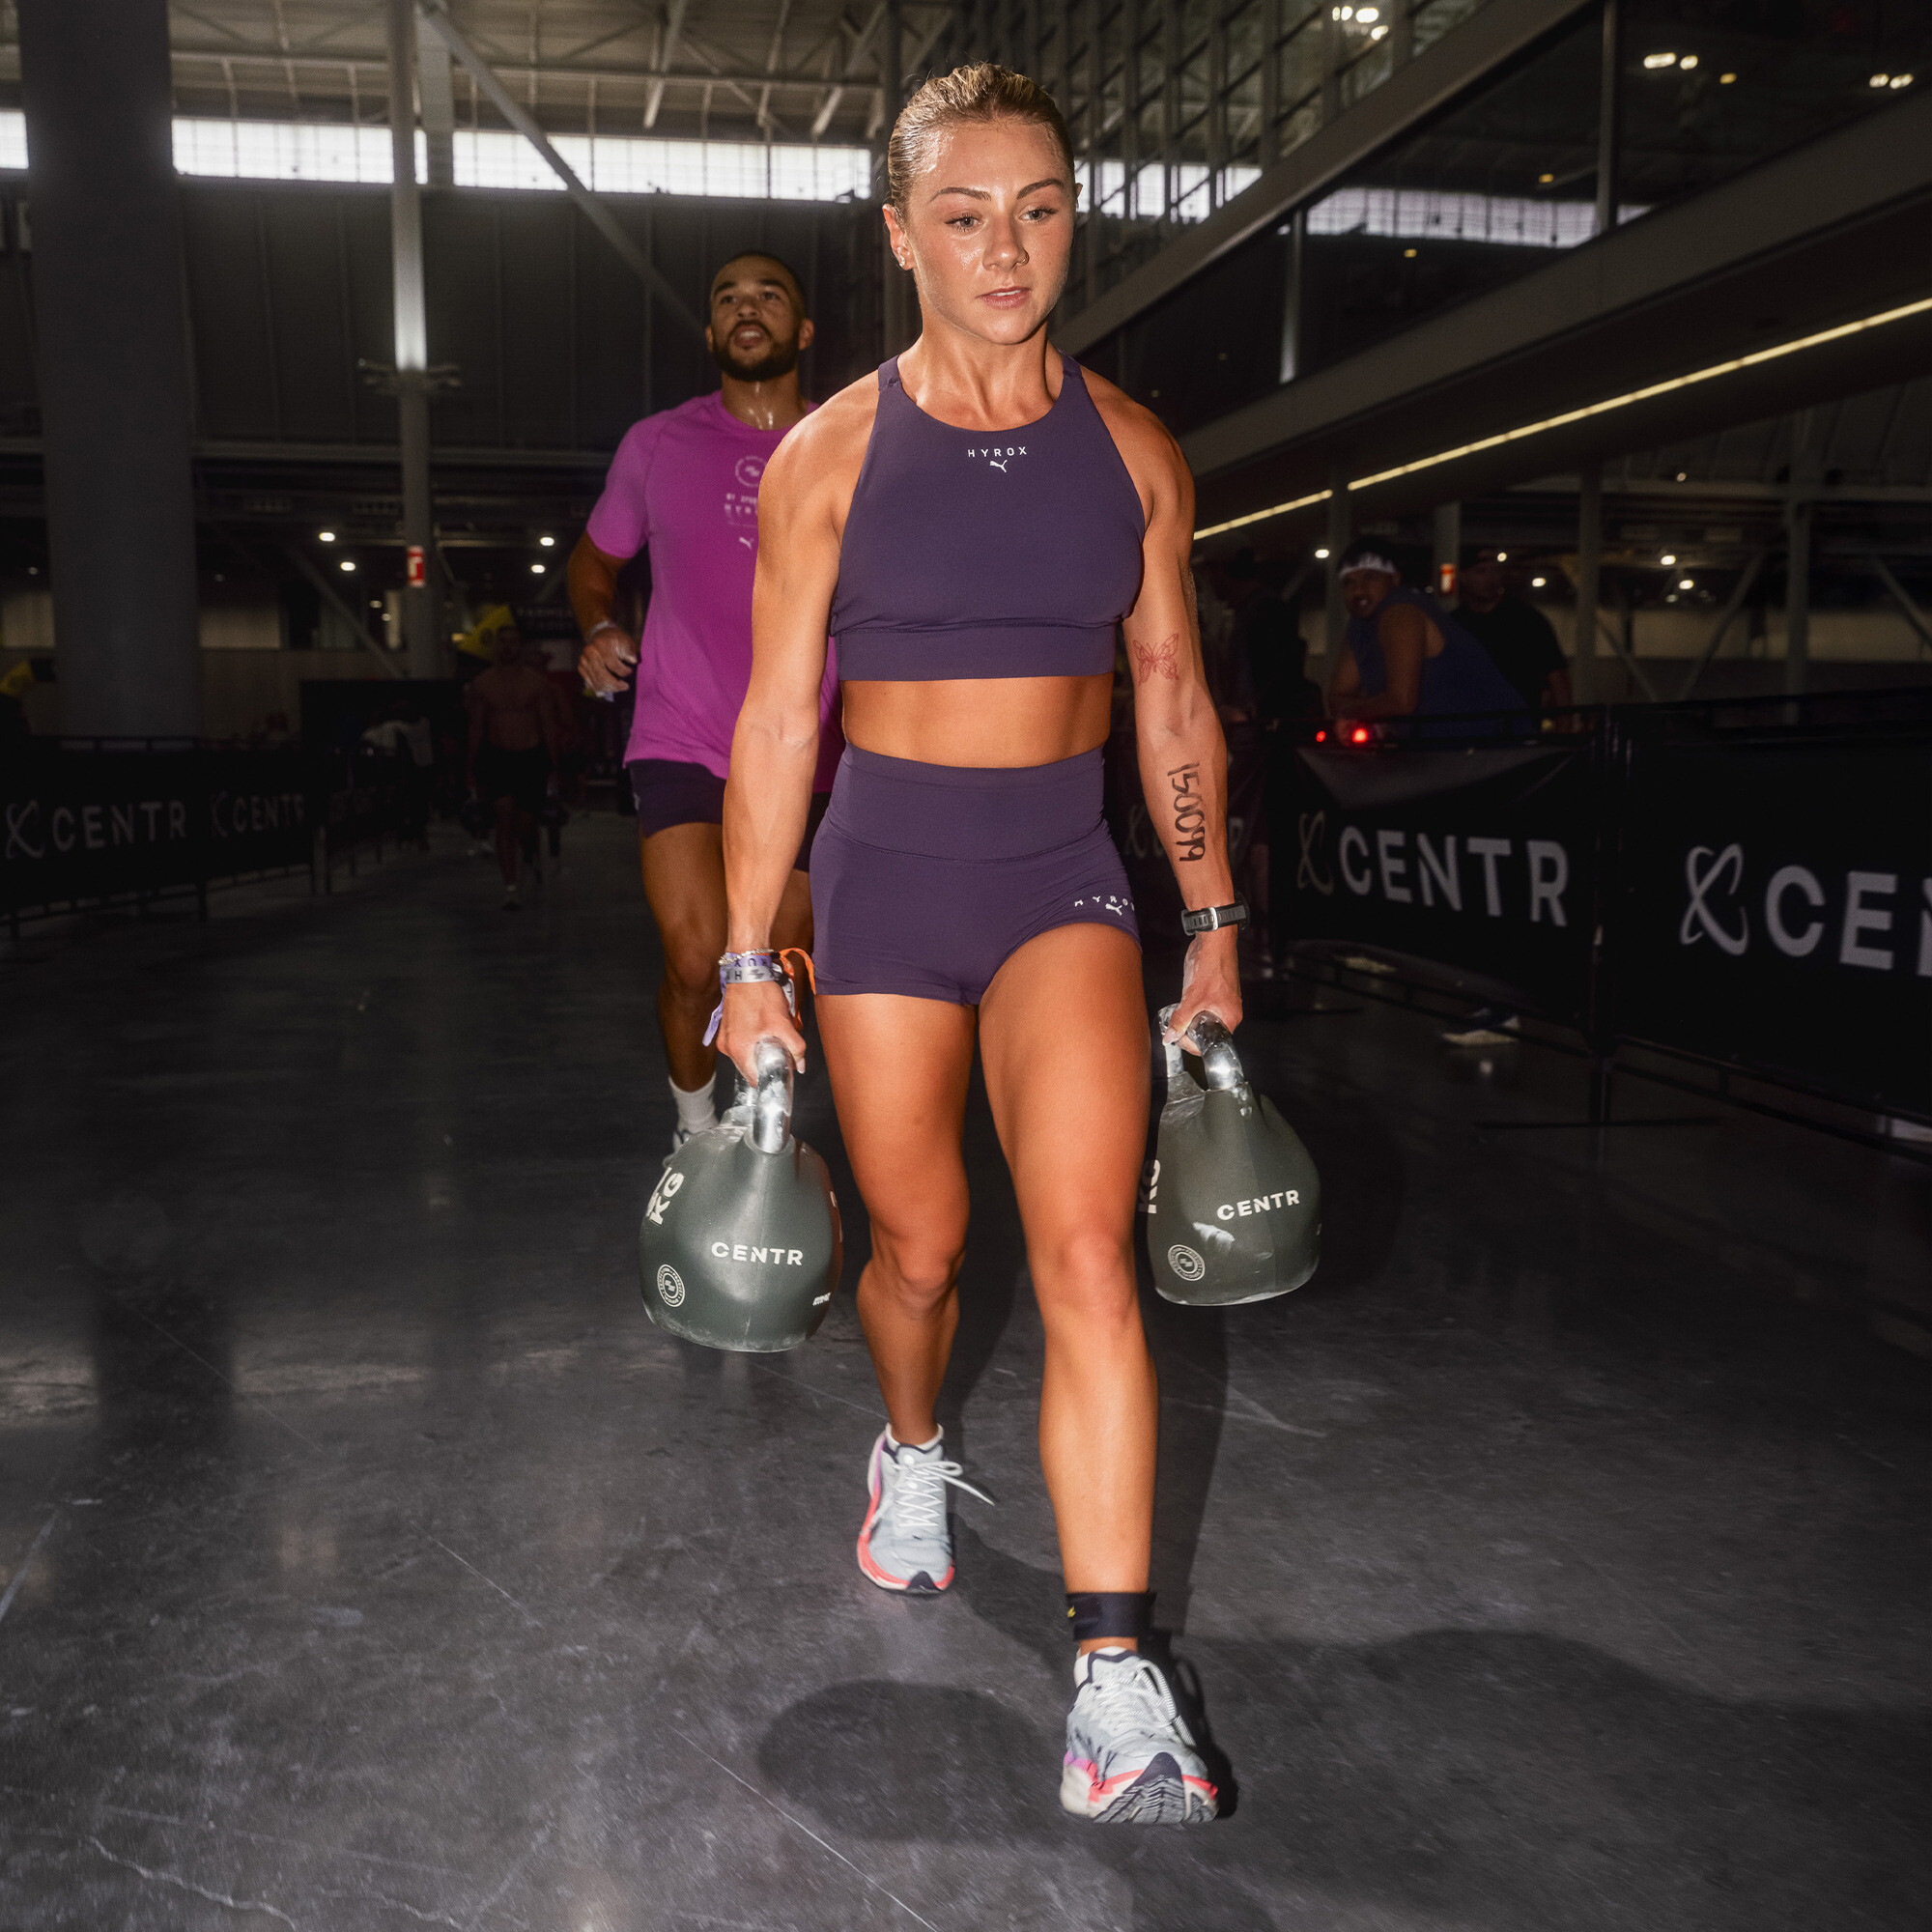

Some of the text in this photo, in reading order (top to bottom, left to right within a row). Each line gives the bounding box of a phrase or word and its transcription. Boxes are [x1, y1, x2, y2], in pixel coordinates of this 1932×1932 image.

[967, 445, 1028, 459] HYROX
[51, 799, 187, 853] CENTR
[1167, 761, 1206, 863] 150099
[1338, 825, 1570, 928] CENTR
[648, 1171, 685, 1227] KG
[1216, 1189, 1300, 1221] CENTR
[711, 1241, 804, 1265] CENTR
